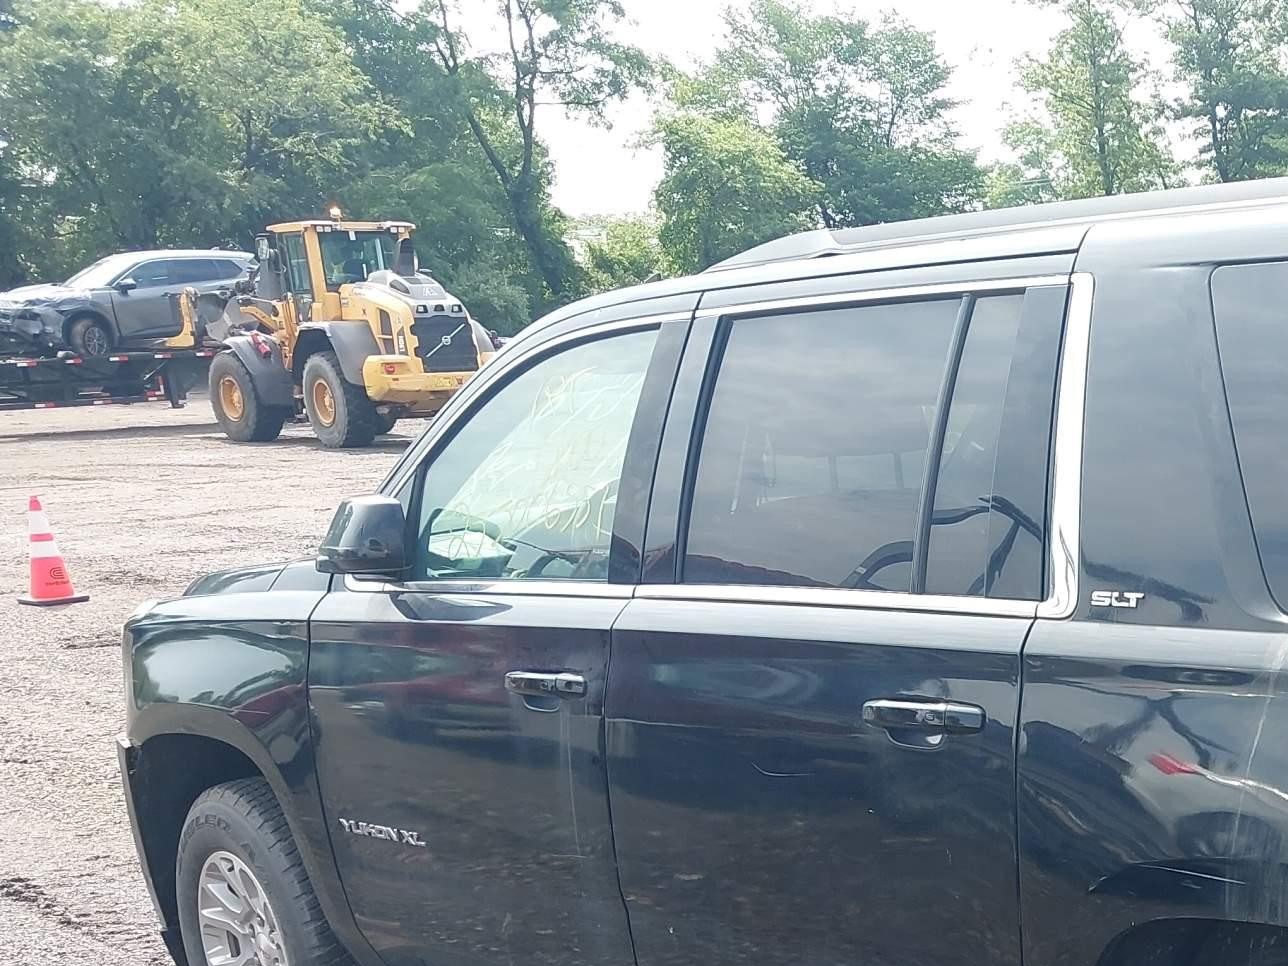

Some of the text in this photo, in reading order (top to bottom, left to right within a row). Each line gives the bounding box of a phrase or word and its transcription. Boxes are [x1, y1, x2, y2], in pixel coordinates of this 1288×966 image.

[1091, 590, 1145, 608] SLT
[338, 817, 427, 847] YUKON XL
